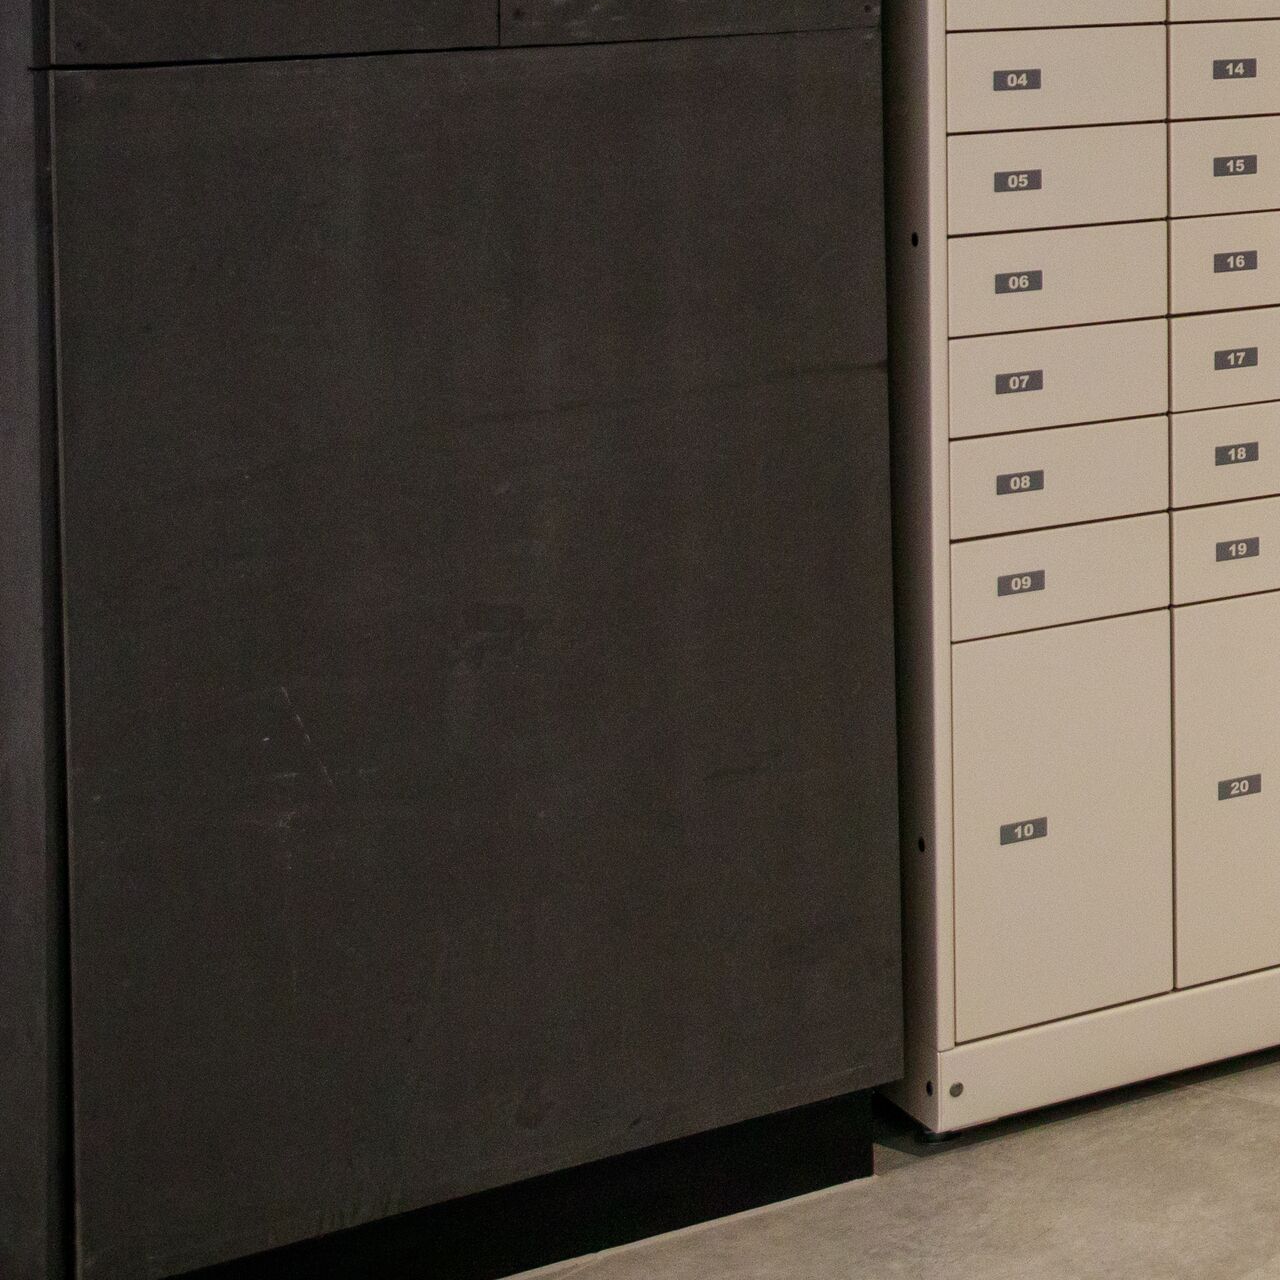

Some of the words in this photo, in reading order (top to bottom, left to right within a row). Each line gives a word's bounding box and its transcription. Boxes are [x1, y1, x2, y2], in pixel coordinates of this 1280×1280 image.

[1226, 62, 1244, 75] 14
[1007, 73, 1028, 87] 04
[1226, 159, 1245, 172] 15
[1008, 174, 1028, 188] 05
[1227, 255, 1245, 268] 16
[1008, 275, 1029, 290] 06
[1227, 352, 1246, 365] 17
[1009, 375, 1030, 390] 07
[1228, 447, 1246, 461] 18
[1010, 475, 1030, 490] 08
[1229, 542, 1247, 556] 19
[1011, 576, 1032, 591] 09
[1230, 780, 1249, 795] 20
[1014, 824, 1034, 839] 10
